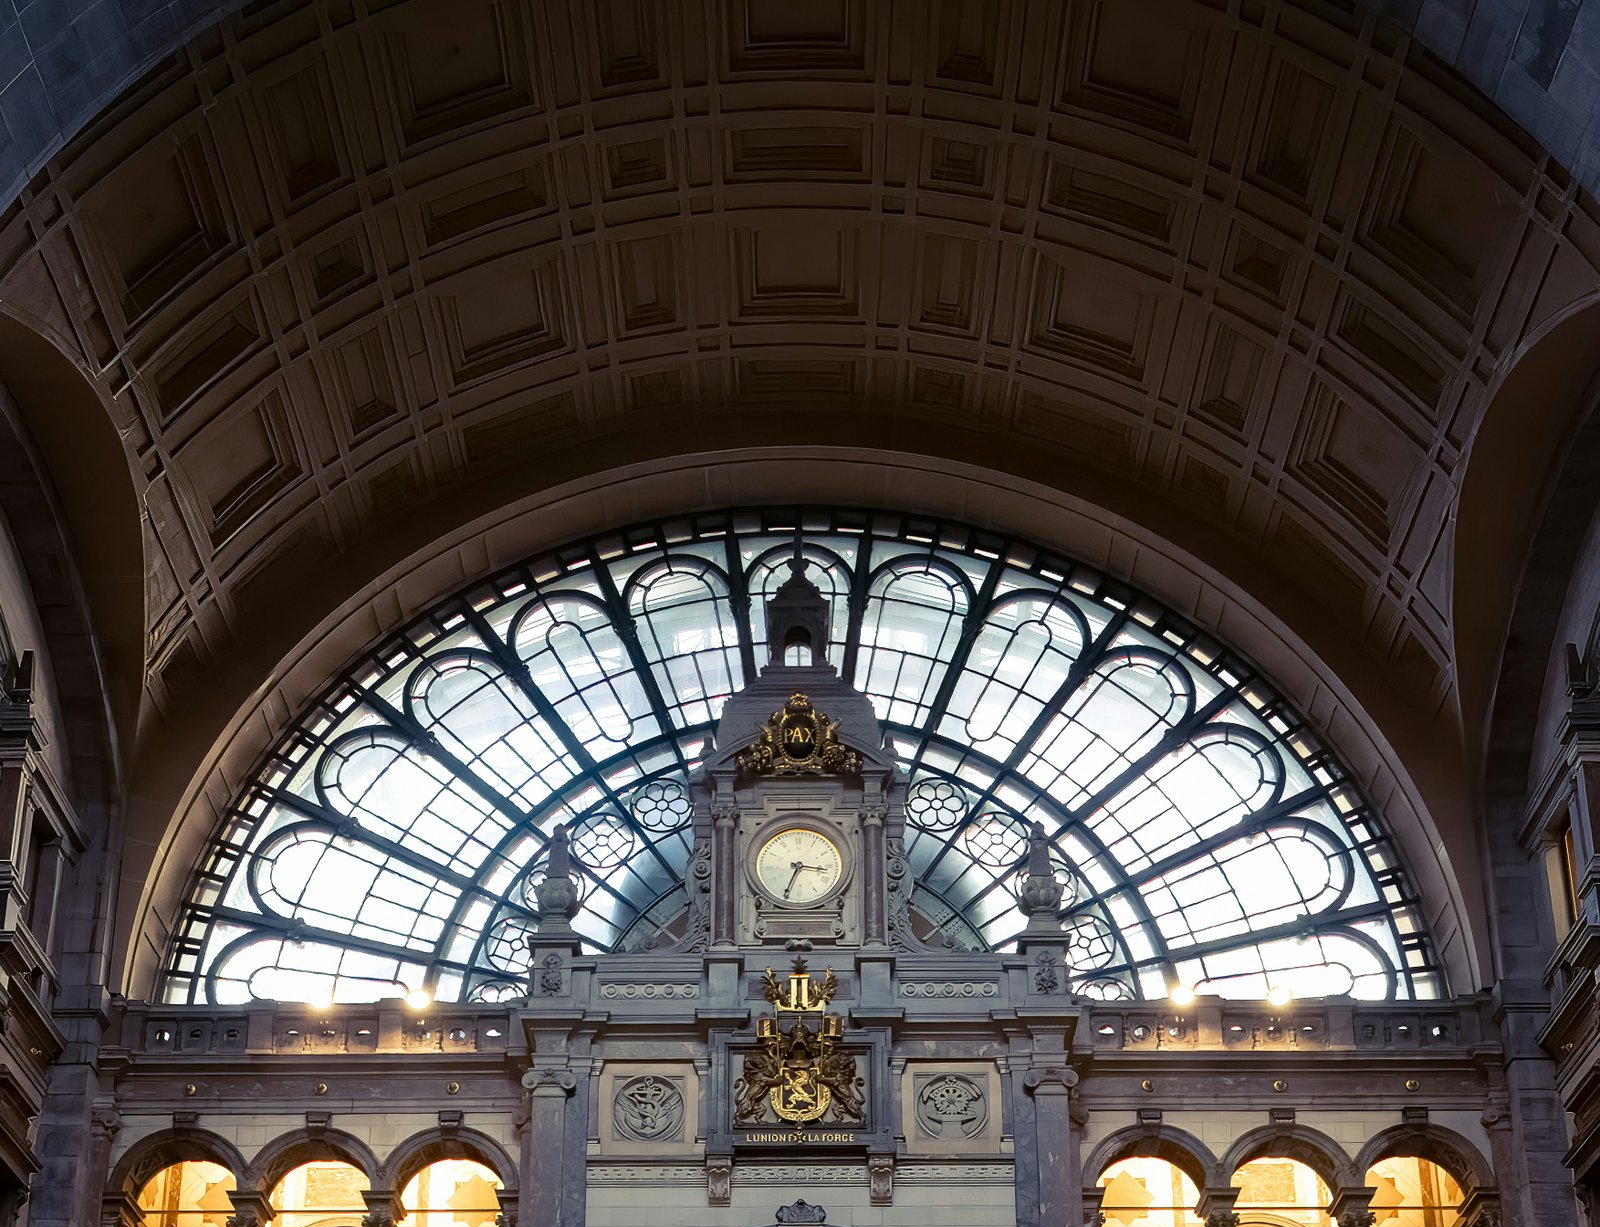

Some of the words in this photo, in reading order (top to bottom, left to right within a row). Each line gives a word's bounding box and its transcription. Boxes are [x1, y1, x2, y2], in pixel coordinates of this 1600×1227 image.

[784, 727, 815, 744] PAX
[808, 1134, 820, 1142] LA
[822, 1133, 854, 1142] FORCE
